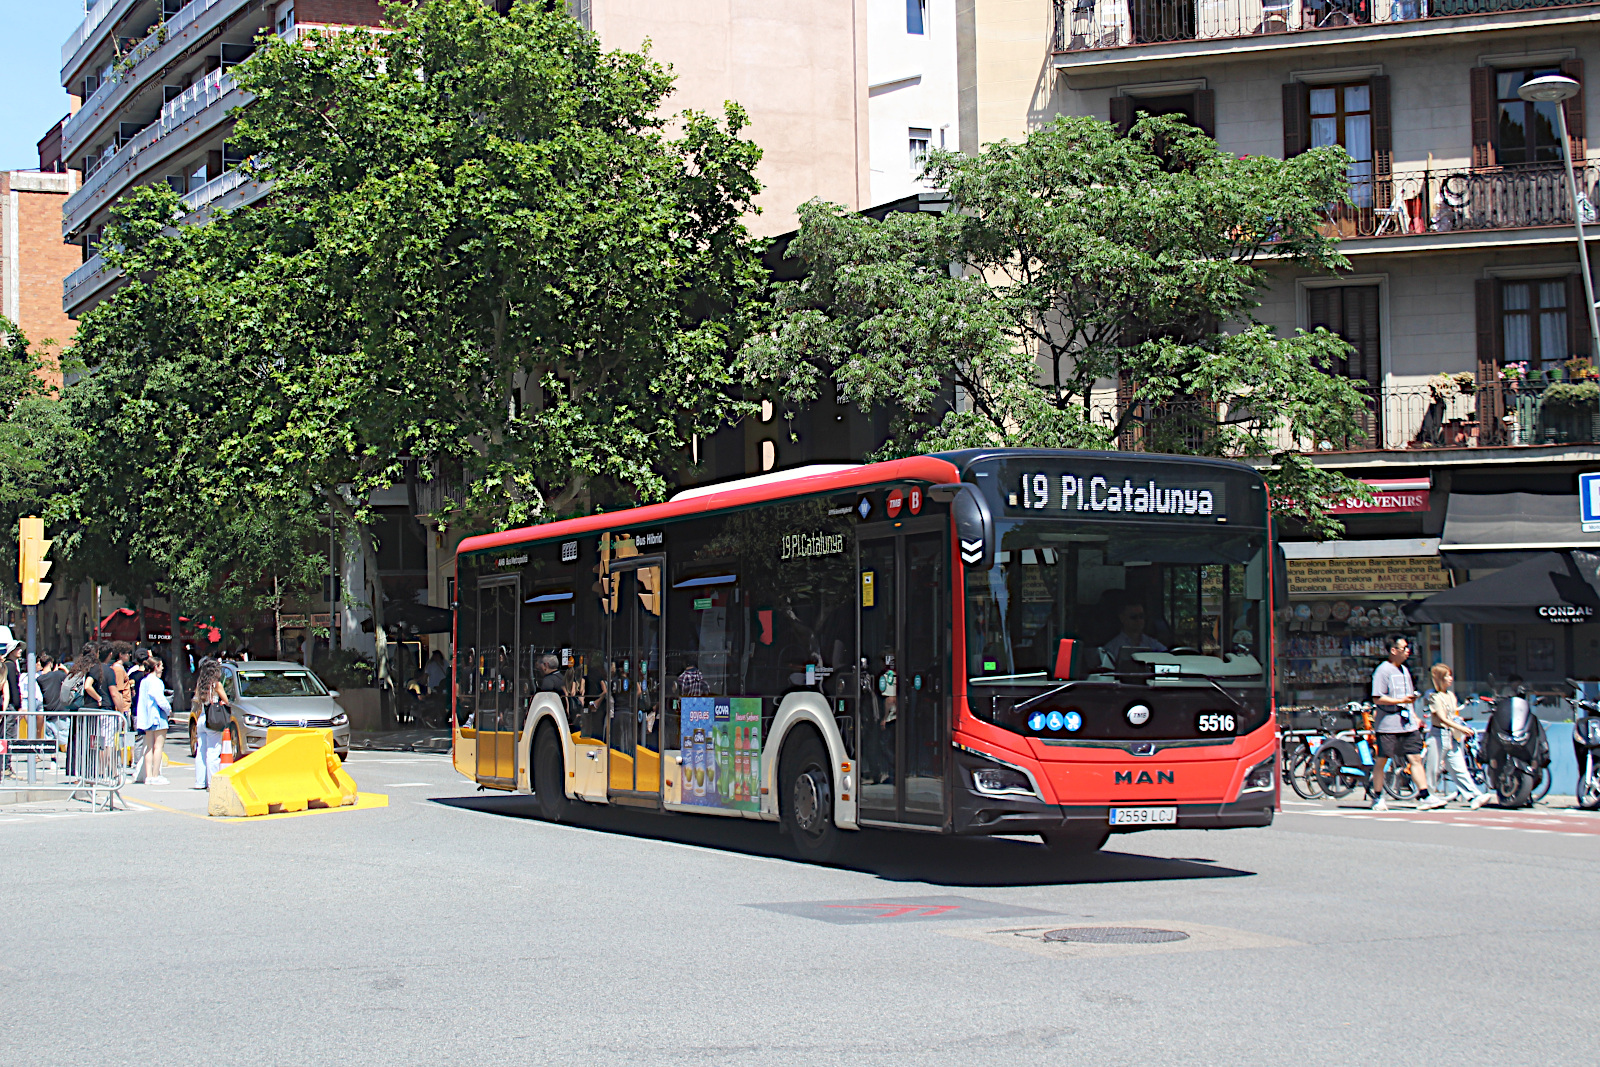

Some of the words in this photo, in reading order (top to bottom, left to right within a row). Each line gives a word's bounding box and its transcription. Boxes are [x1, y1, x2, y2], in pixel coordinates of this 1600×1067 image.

[1023, 474, 1048, 508] 19
[889, 498, 902, 508] TMB
[911, 491, 919, 509] B
[1346, 495, 1423, 508] SOUVENIRS
[635, 535, 646, 546] Bus
[781, 535, 790, 560] 19
[1369, 558, 1406, 566] Barcelona
[1308, 567, 1345, 575] Barcelona
[1290, 584, 1327, 592] Barcelona
[1539, 606, 1592, 616] CONDAL
[715, 705, 729, 715] GOYA
[1199, 715, 1235, 731] 5516
[1113, 770, 1174, 784] MAN
[1118, 810, 1148, 822] 2559
[1151, 809, 1174, 821] LCJ
